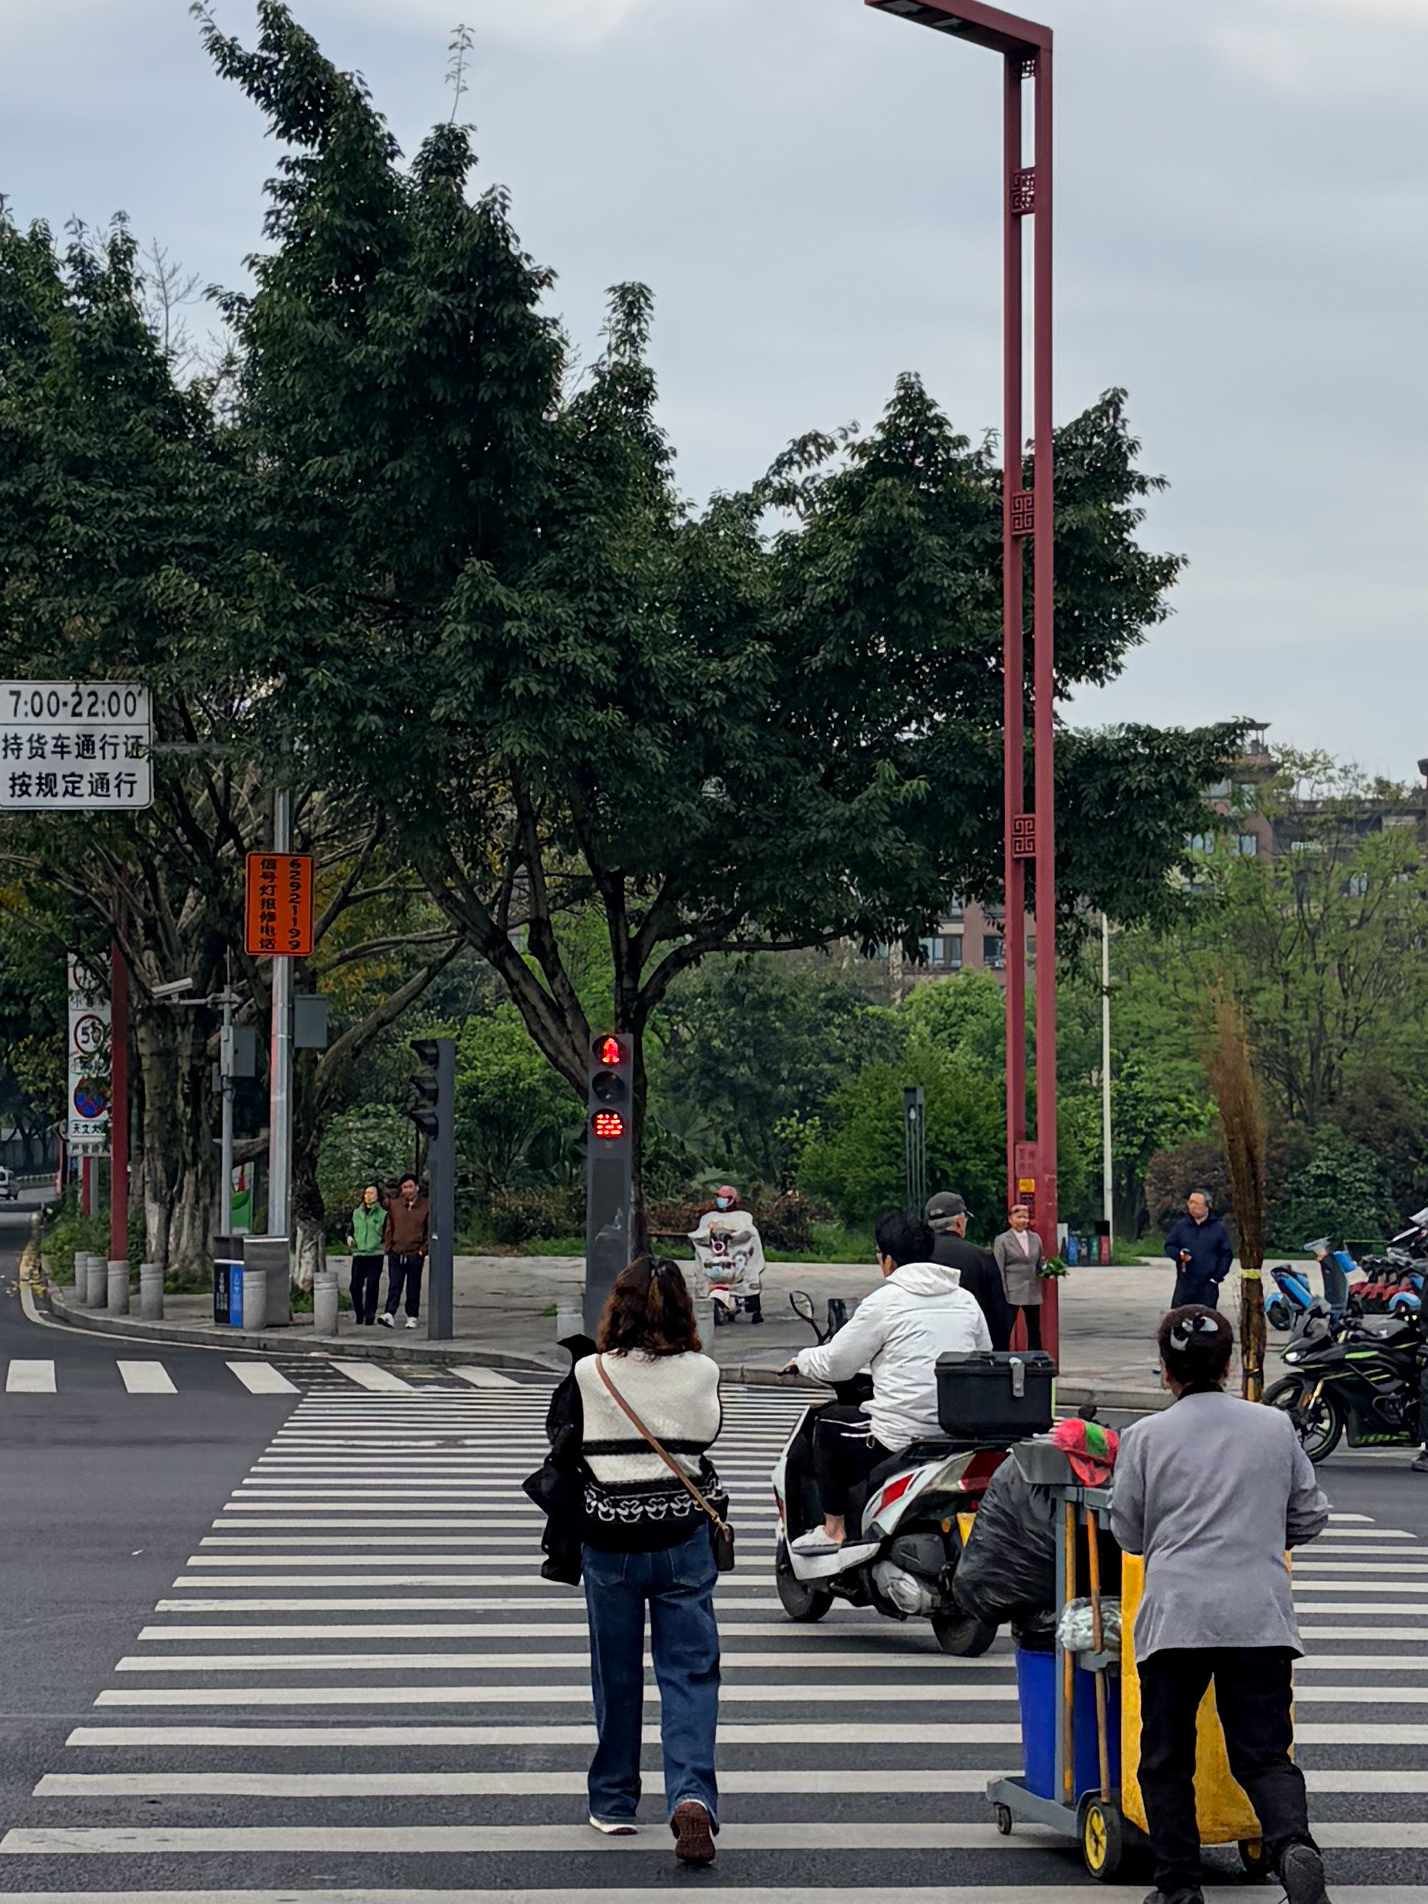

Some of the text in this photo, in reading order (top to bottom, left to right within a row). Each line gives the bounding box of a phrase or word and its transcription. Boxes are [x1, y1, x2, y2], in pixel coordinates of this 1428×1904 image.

[9, 689, 138, 718] 7:00-22:00
[2, 733, 143, 761] 持货车通行证
[9, 771, 138, 798] 按规定通行
[260, 858, 277, 950] 信号灯报修电话
[288, 859, 302, 950] 62921199
